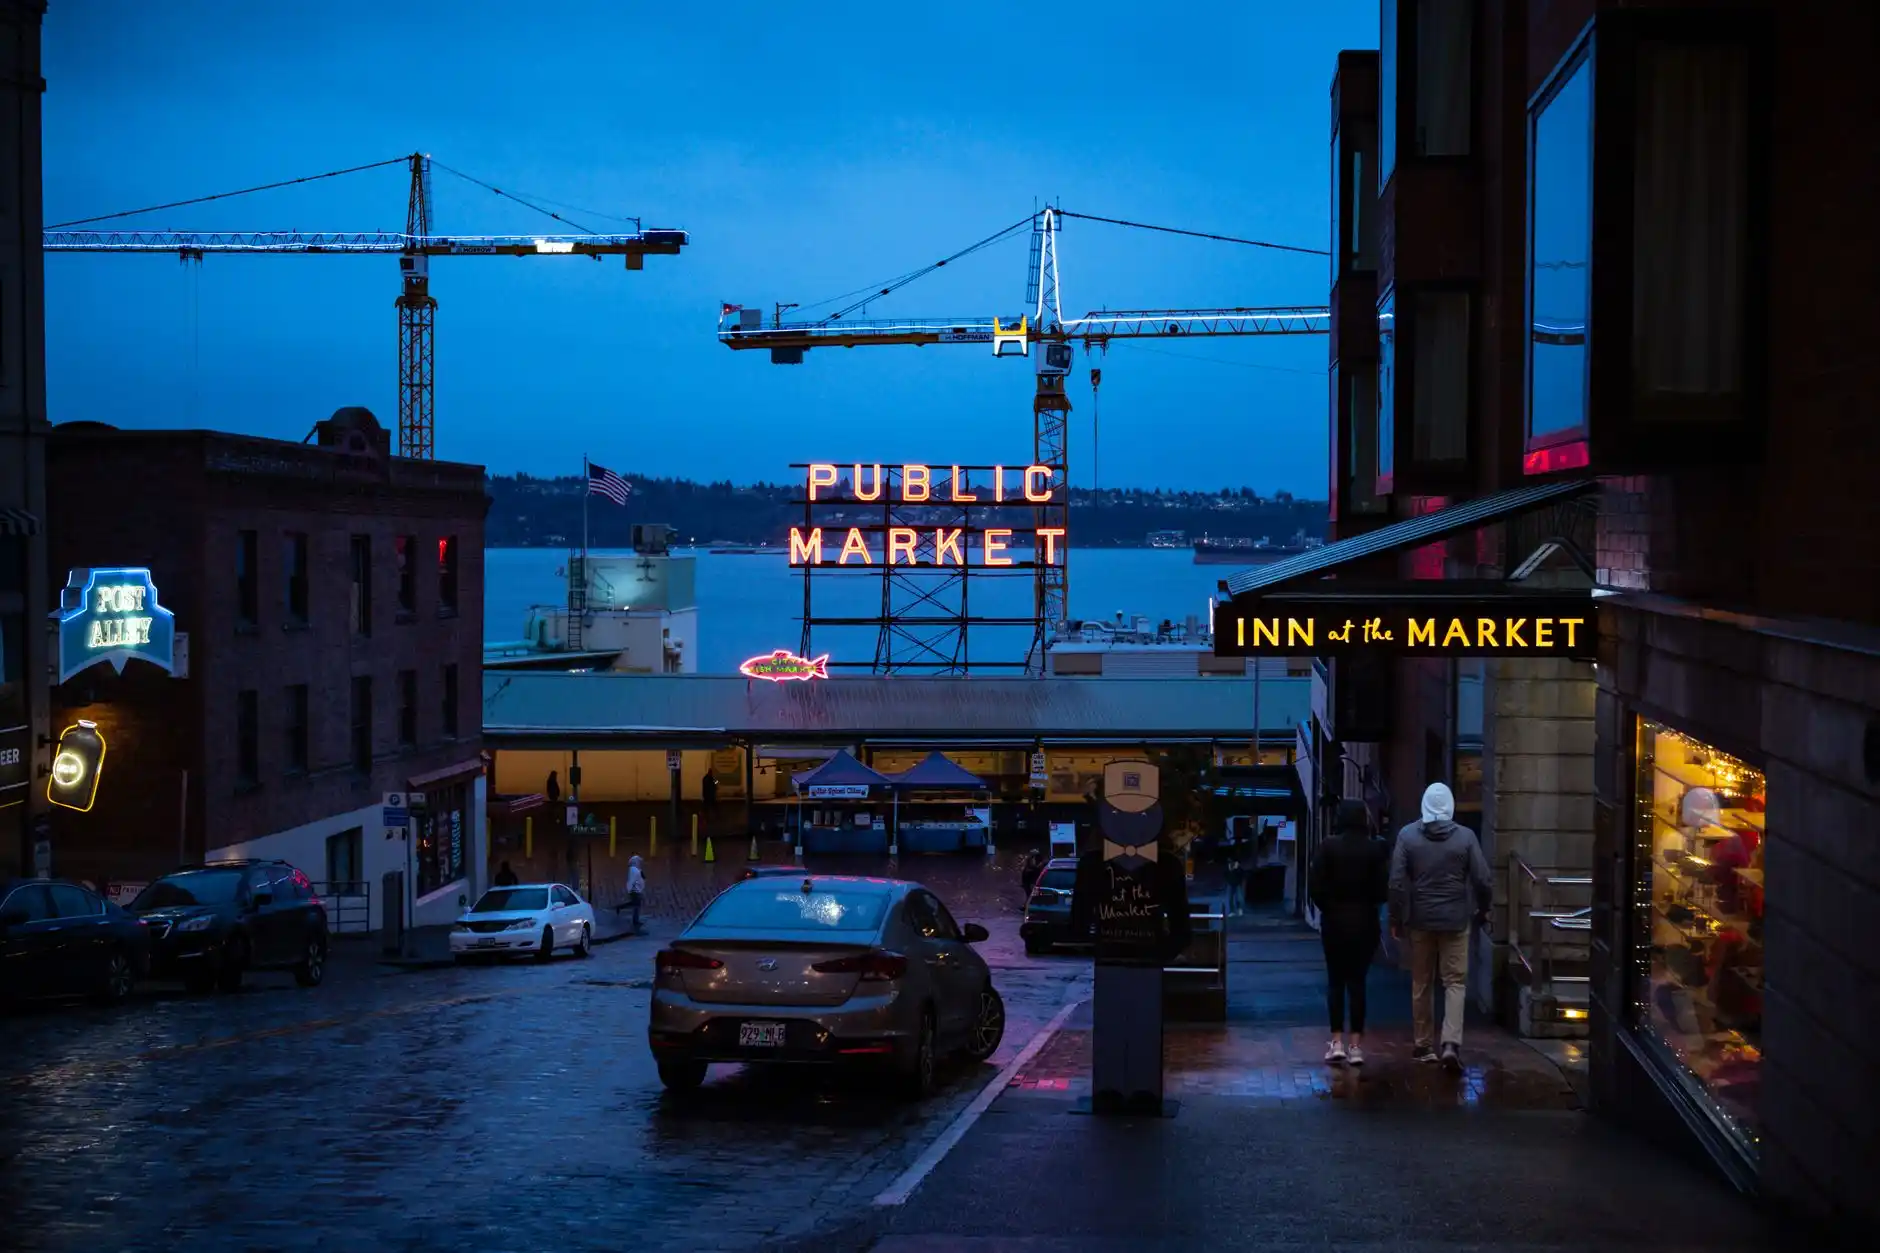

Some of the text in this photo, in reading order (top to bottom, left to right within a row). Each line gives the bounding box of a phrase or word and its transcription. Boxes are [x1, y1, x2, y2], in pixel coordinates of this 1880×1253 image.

[952, 333, 990, 341] HOFFMAN
[807, 463, 1053, 502] PUBLIC
[789, 526, 1066, 566] MARKET
[97, 584, 147, 613] POST
[88, 616, 153, 648] ALLEY
[1236, 616, 1585, 648] INN at the MARKET
[771, 657, 798, 665] CITY
[1106, 866, 1134, 890] Inn
[1111, 884, 1152, 903] at the
[1099, 902, 1161, 922] Market
